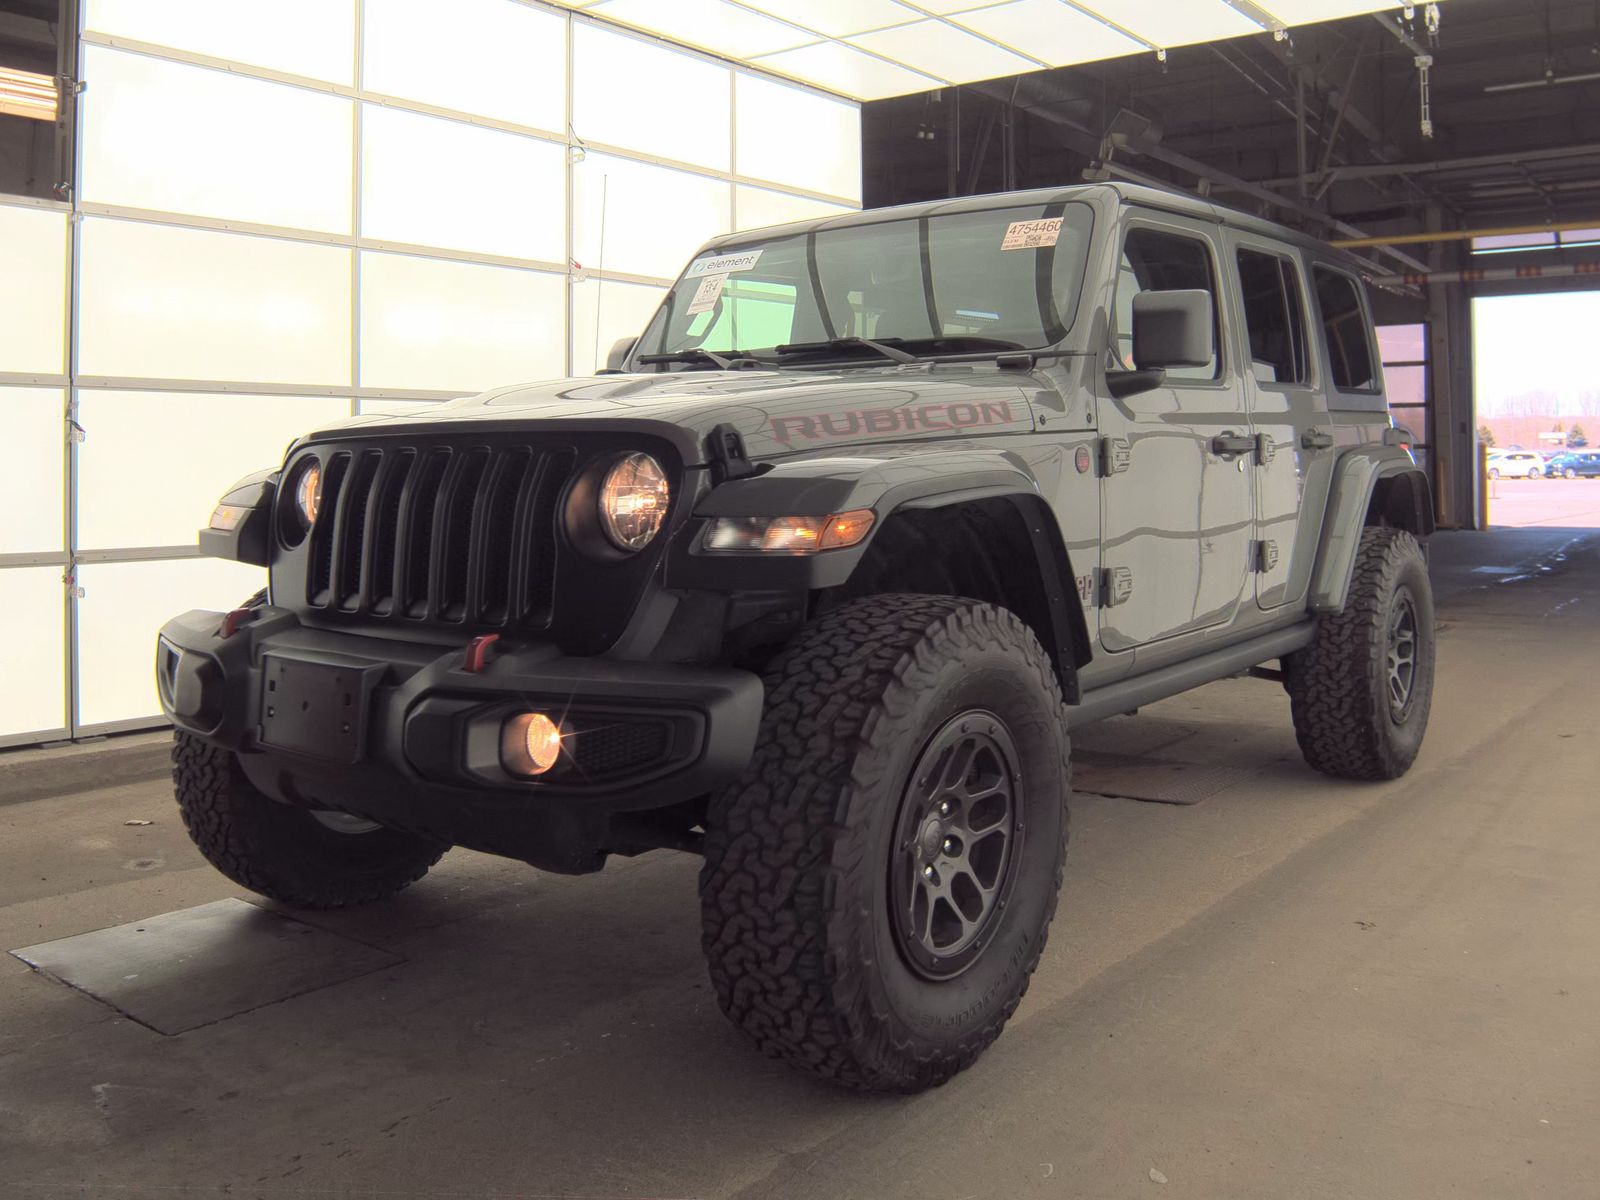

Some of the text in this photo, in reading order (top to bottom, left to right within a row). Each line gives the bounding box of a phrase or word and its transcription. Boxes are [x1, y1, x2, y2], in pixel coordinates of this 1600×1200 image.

[1009, 220, 1063, 235] 4754460
[707, 255, 754, 269] element
[770, 400, 1012, 444] RUBICON
